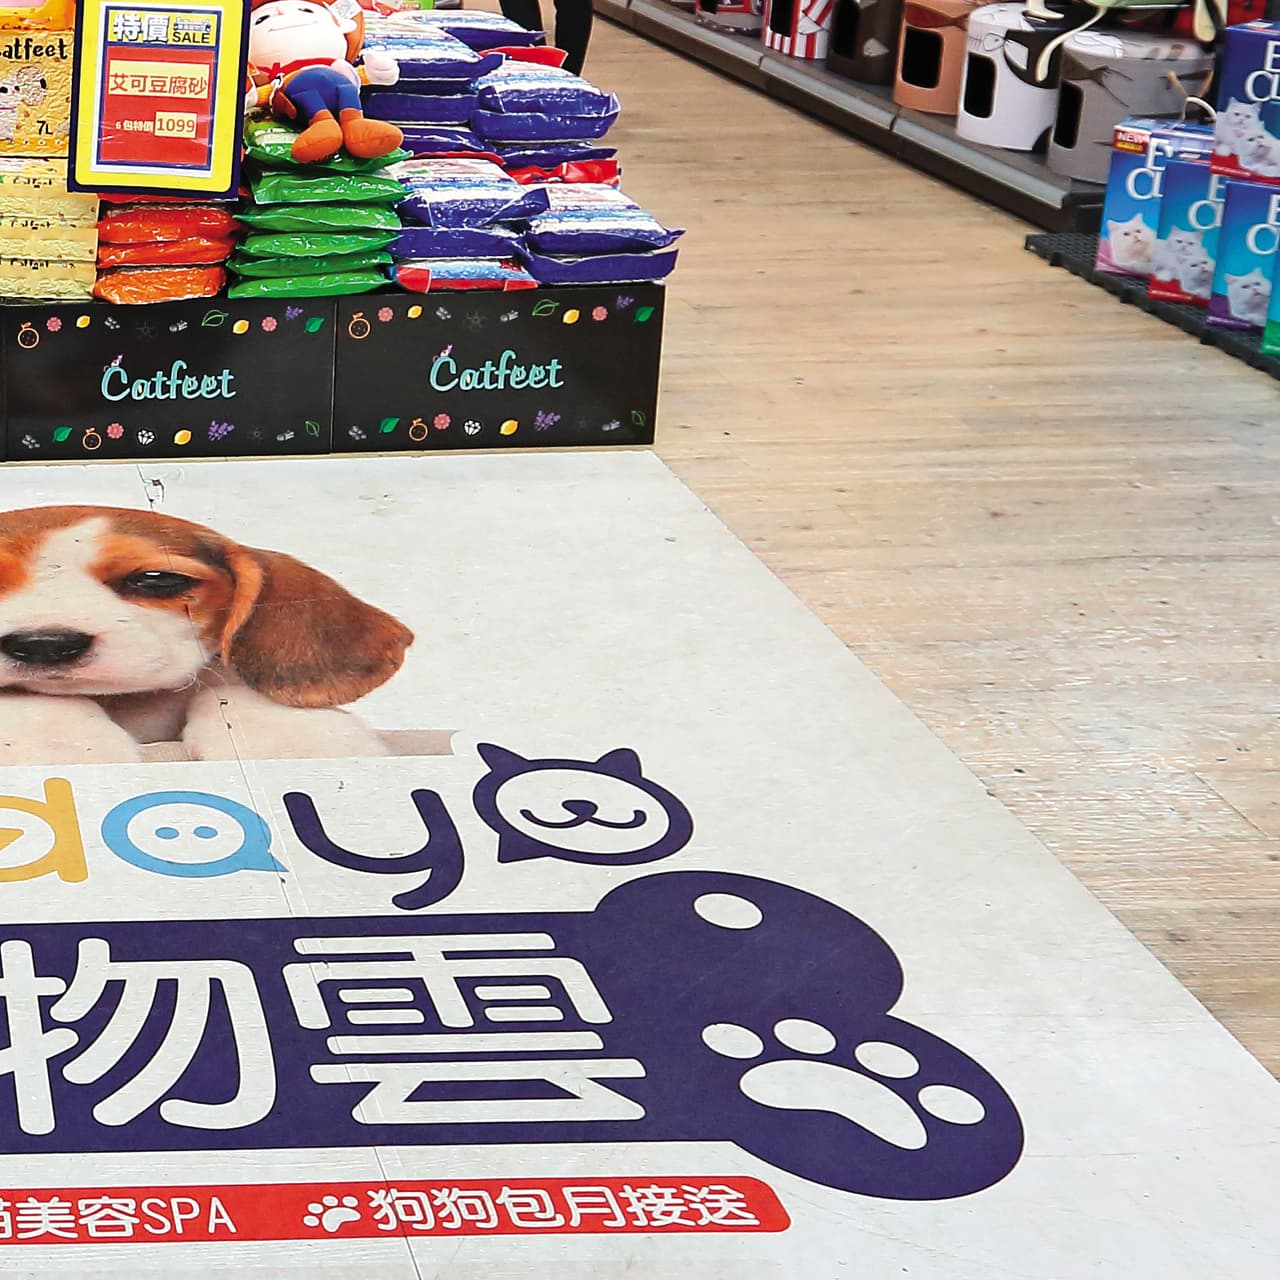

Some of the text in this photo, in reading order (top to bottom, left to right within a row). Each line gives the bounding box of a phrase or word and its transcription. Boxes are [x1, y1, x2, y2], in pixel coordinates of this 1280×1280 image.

[113, 12, 170, 44] 特價
[172, 31, 210, 44] SALE
[109, 73, 209, 96] 艾可豆腐砂
[36, 120, 53, 136] 7L
[156, 117, 196, 133] 1099
[1117, 132, 1144, 144] NEW
[100, 360, 237, 403] Catfeet
[428, 350, 565, 393] Catfeet
[372, 1181, 761, 1231] 狗狗包月接送
